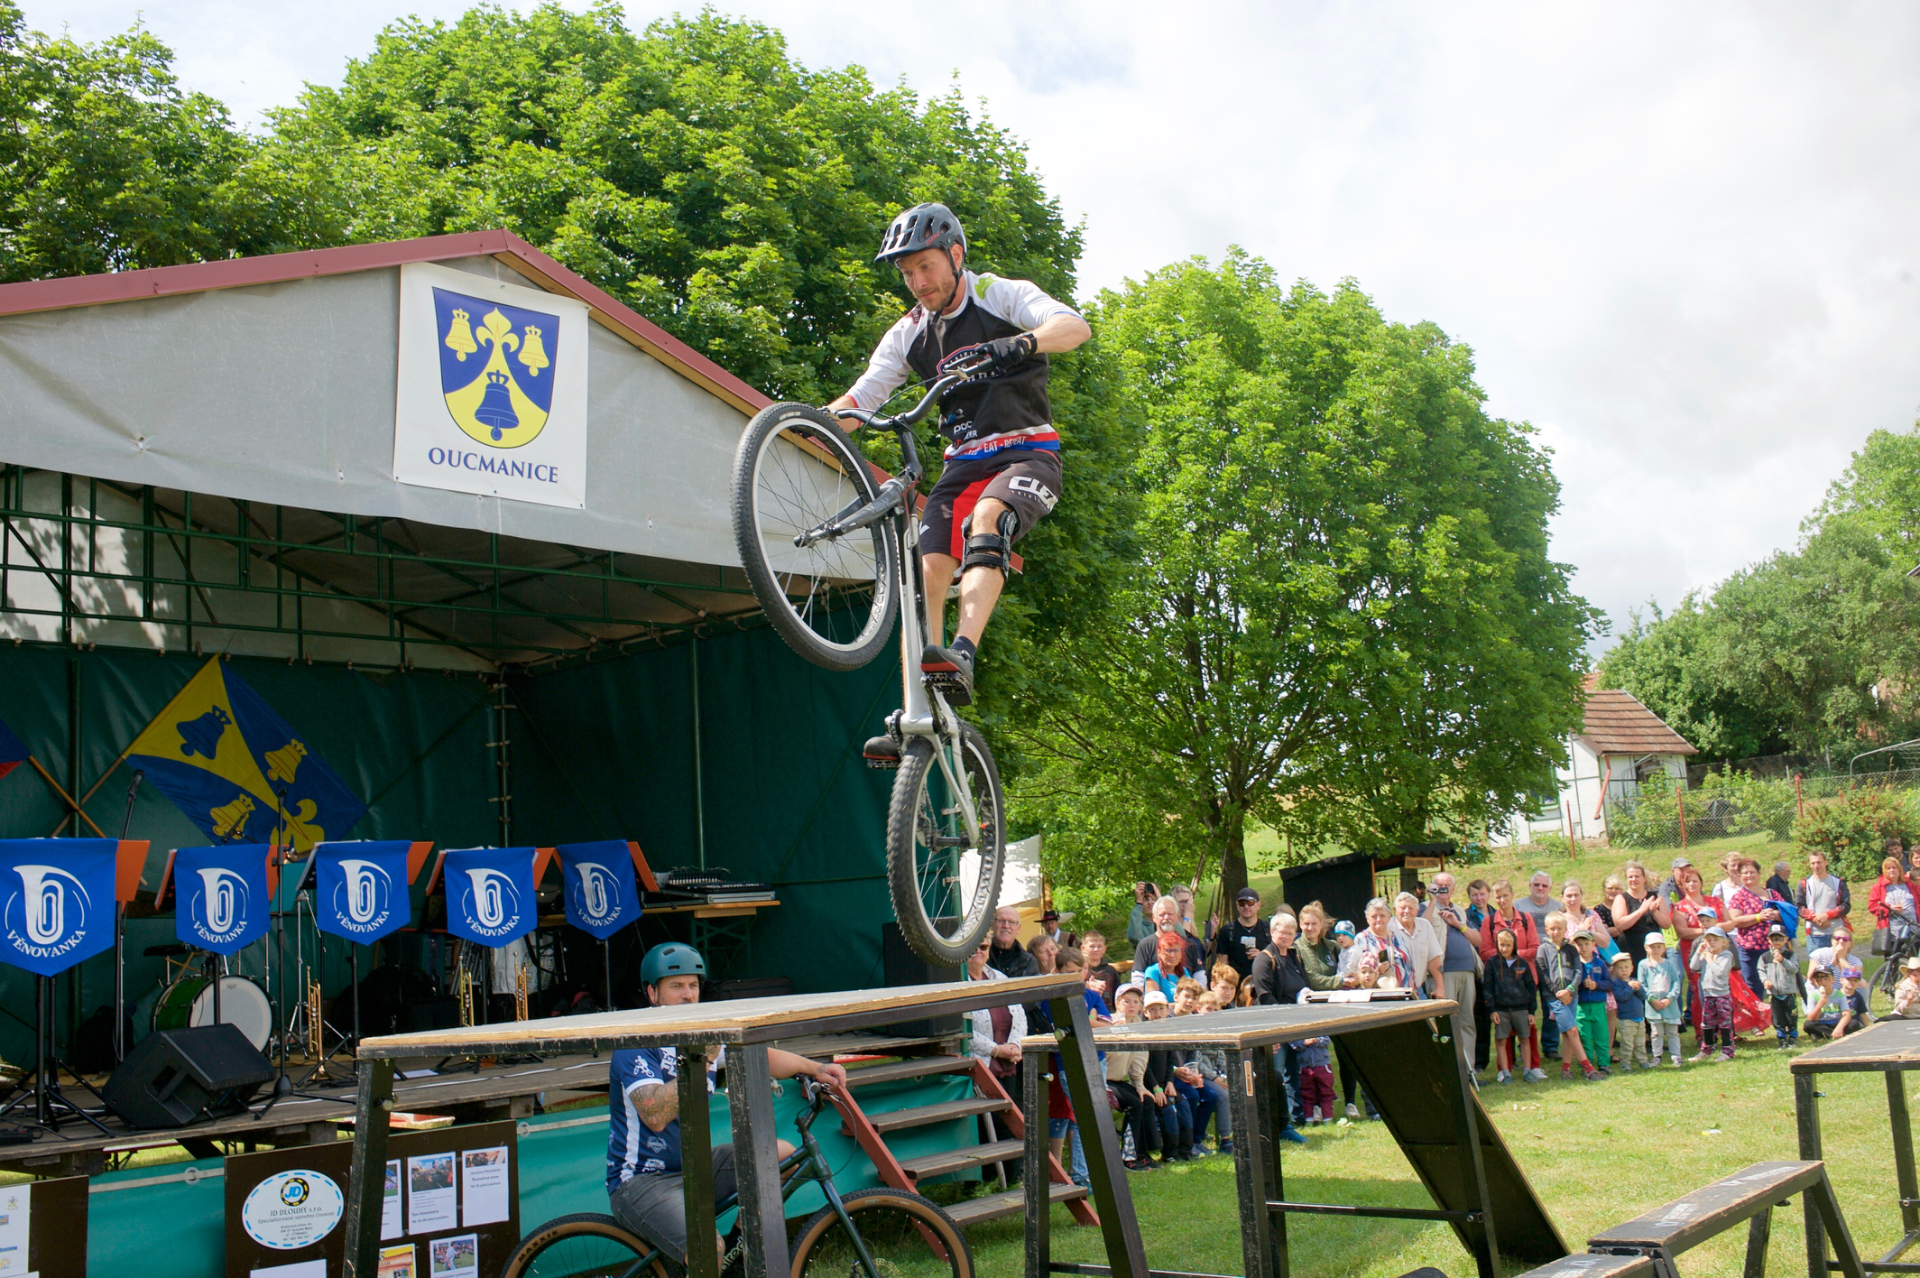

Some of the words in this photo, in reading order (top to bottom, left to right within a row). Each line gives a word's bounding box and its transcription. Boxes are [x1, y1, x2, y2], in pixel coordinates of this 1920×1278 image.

[984, 441, 997, 453] EAT
[428, 447, 558, 483] OUCMANICE
[336, 910, 390, 933] VĚNOVANKA
[465, 915, 520, 937] VĚNOVANKA
[577, 906, 622, 927] VĚNOVANKA
[193, 920, 248, 944] VĚNOVANKA
[6, 929, 87, 958] VĚNOVANKA
[284, 1186, 302, 1198] JD
[279, 1206, 307, 1216] DLOUHÝ
[518, 1230, 558, 1263] MAXXIS
